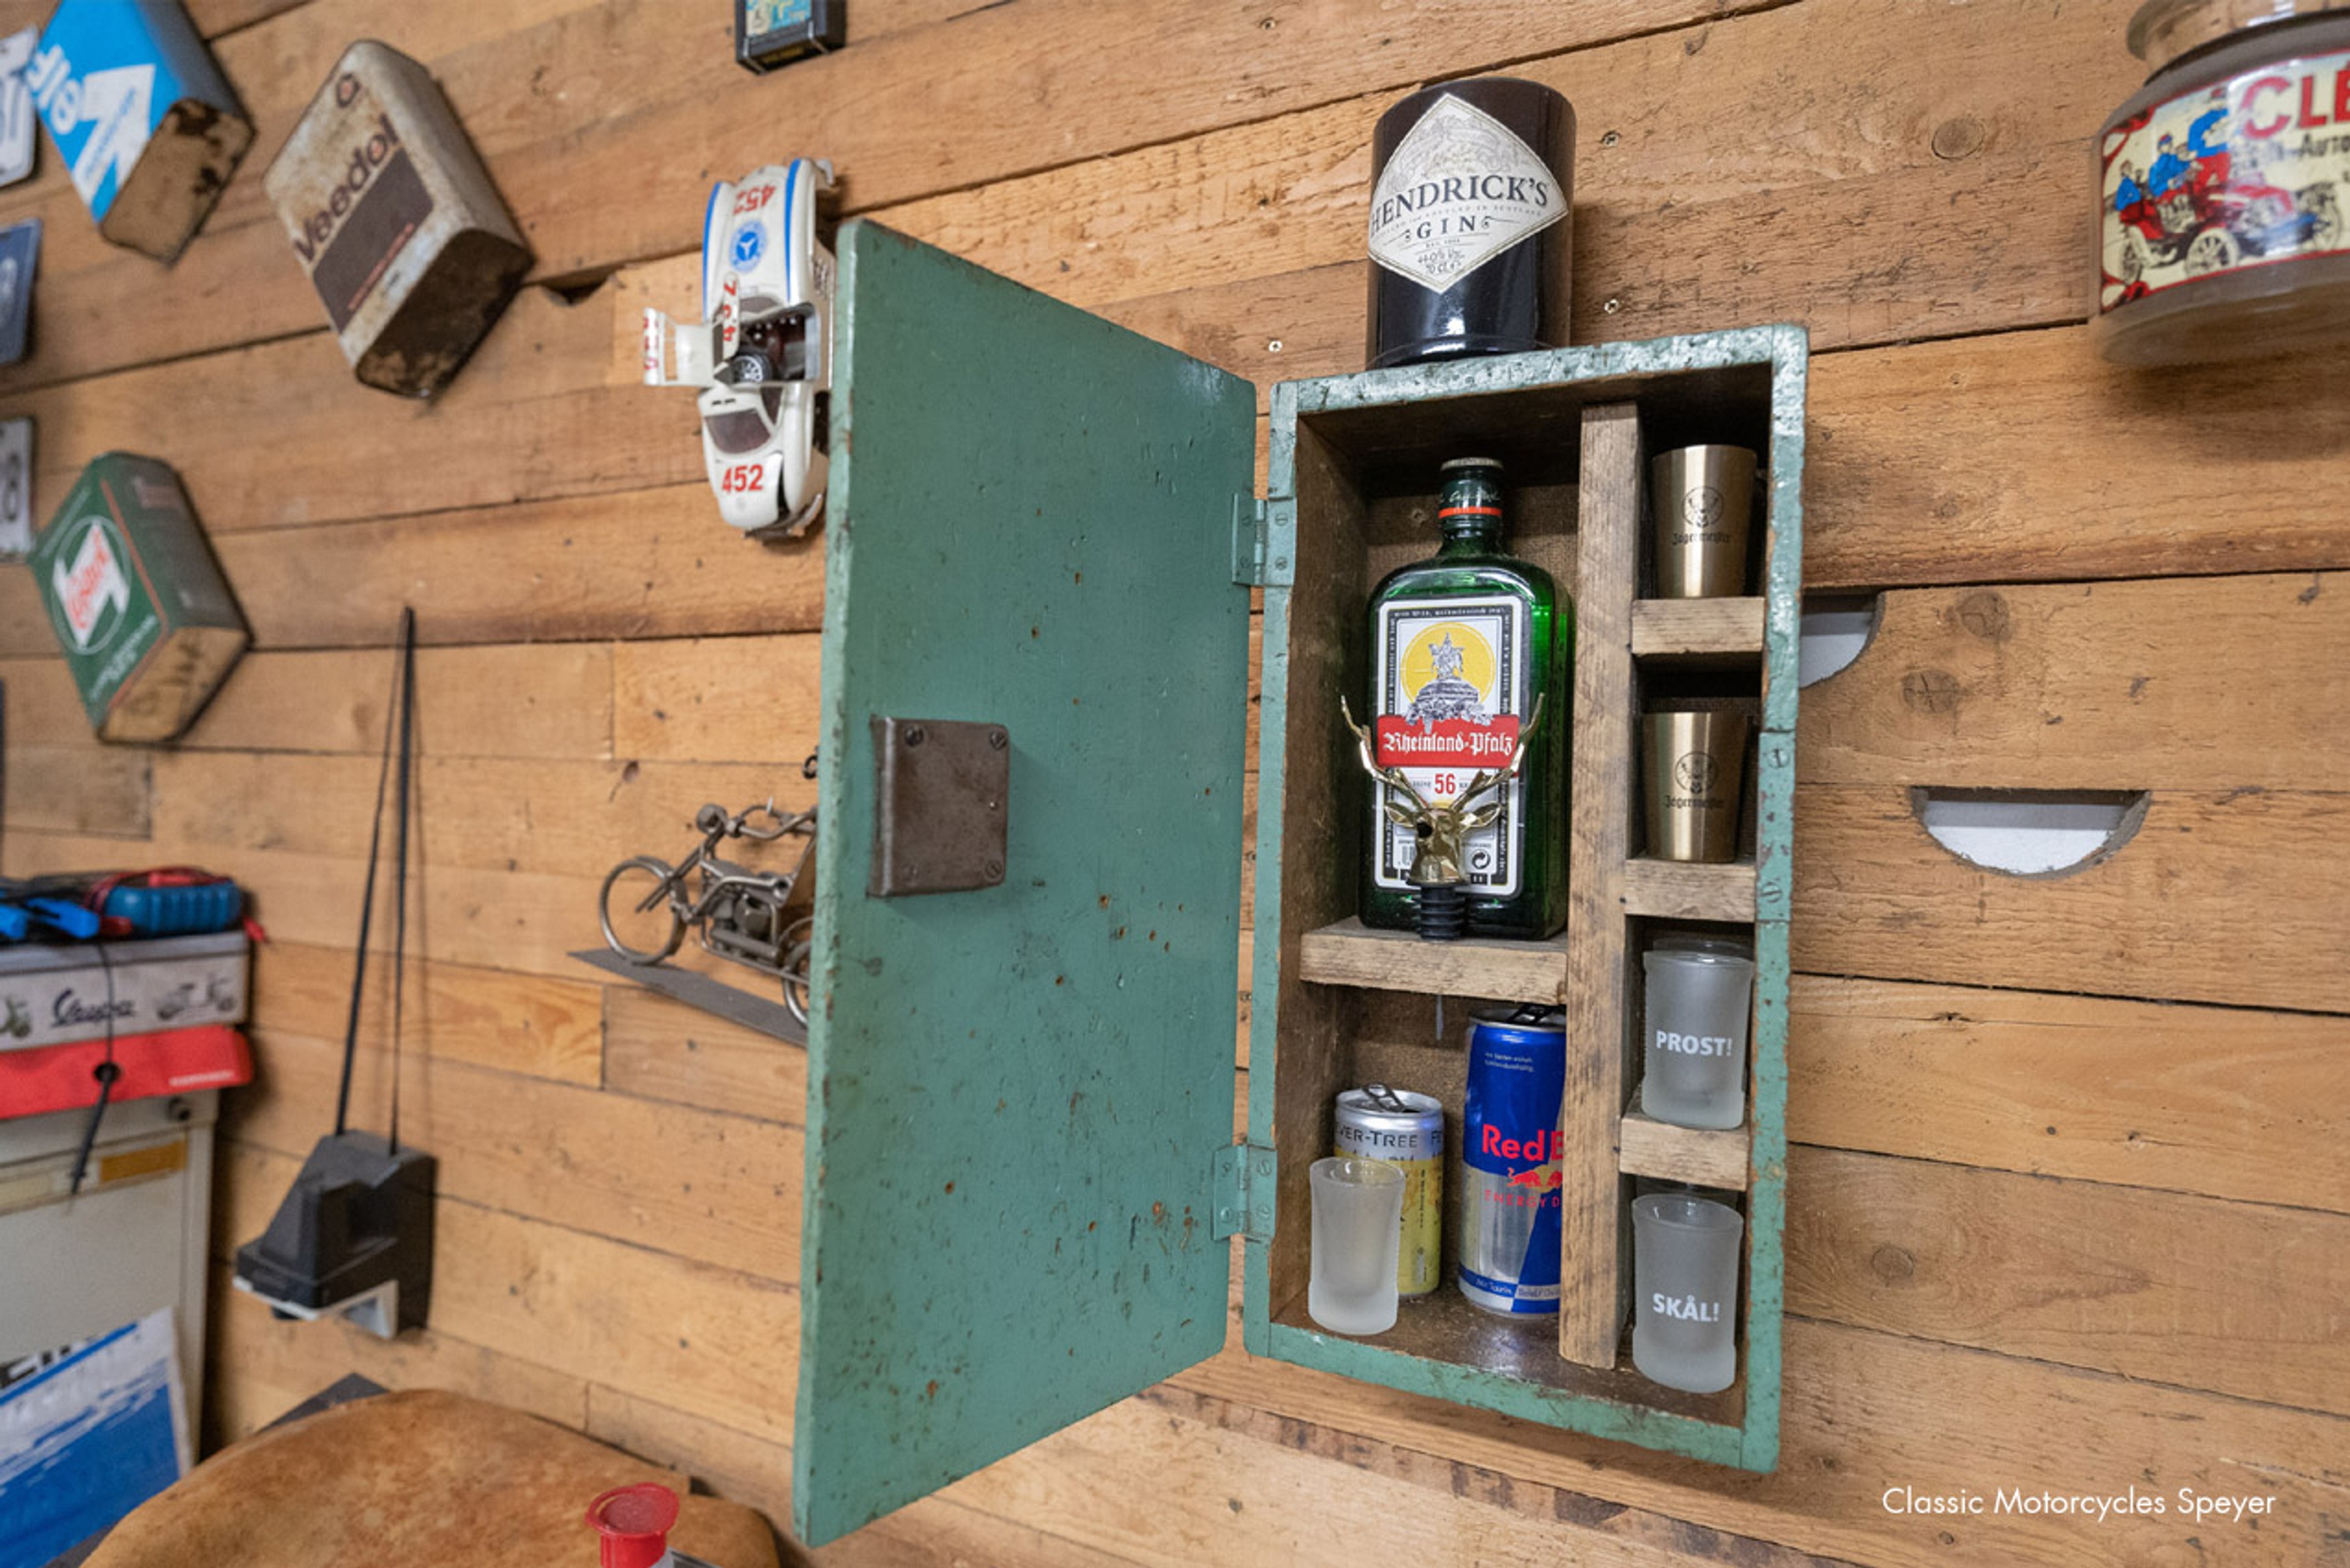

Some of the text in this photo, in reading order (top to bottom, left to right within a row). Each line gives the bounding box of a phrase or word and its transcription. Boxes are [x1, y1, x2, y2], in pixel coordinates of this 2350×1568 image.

[293, 112, 400, 261] Veedol
[1371, 174, 1549, 239] HENDRICK'S
[1417, 215, 1477, 239] GIN
[722, 463, 763, 495] 452
[1383, 731, 1513, 756] Rheinland-Pfalz
[1434, 772, 1457, 794] 56
[1656, 1029, 1733, 1056] PROST!
[1482, 1124, 1545, 1162] Red
[1483, 1189, 1547, 1208] ENERGY
[1653, 1293, 1720, 1322] SKÅL!
